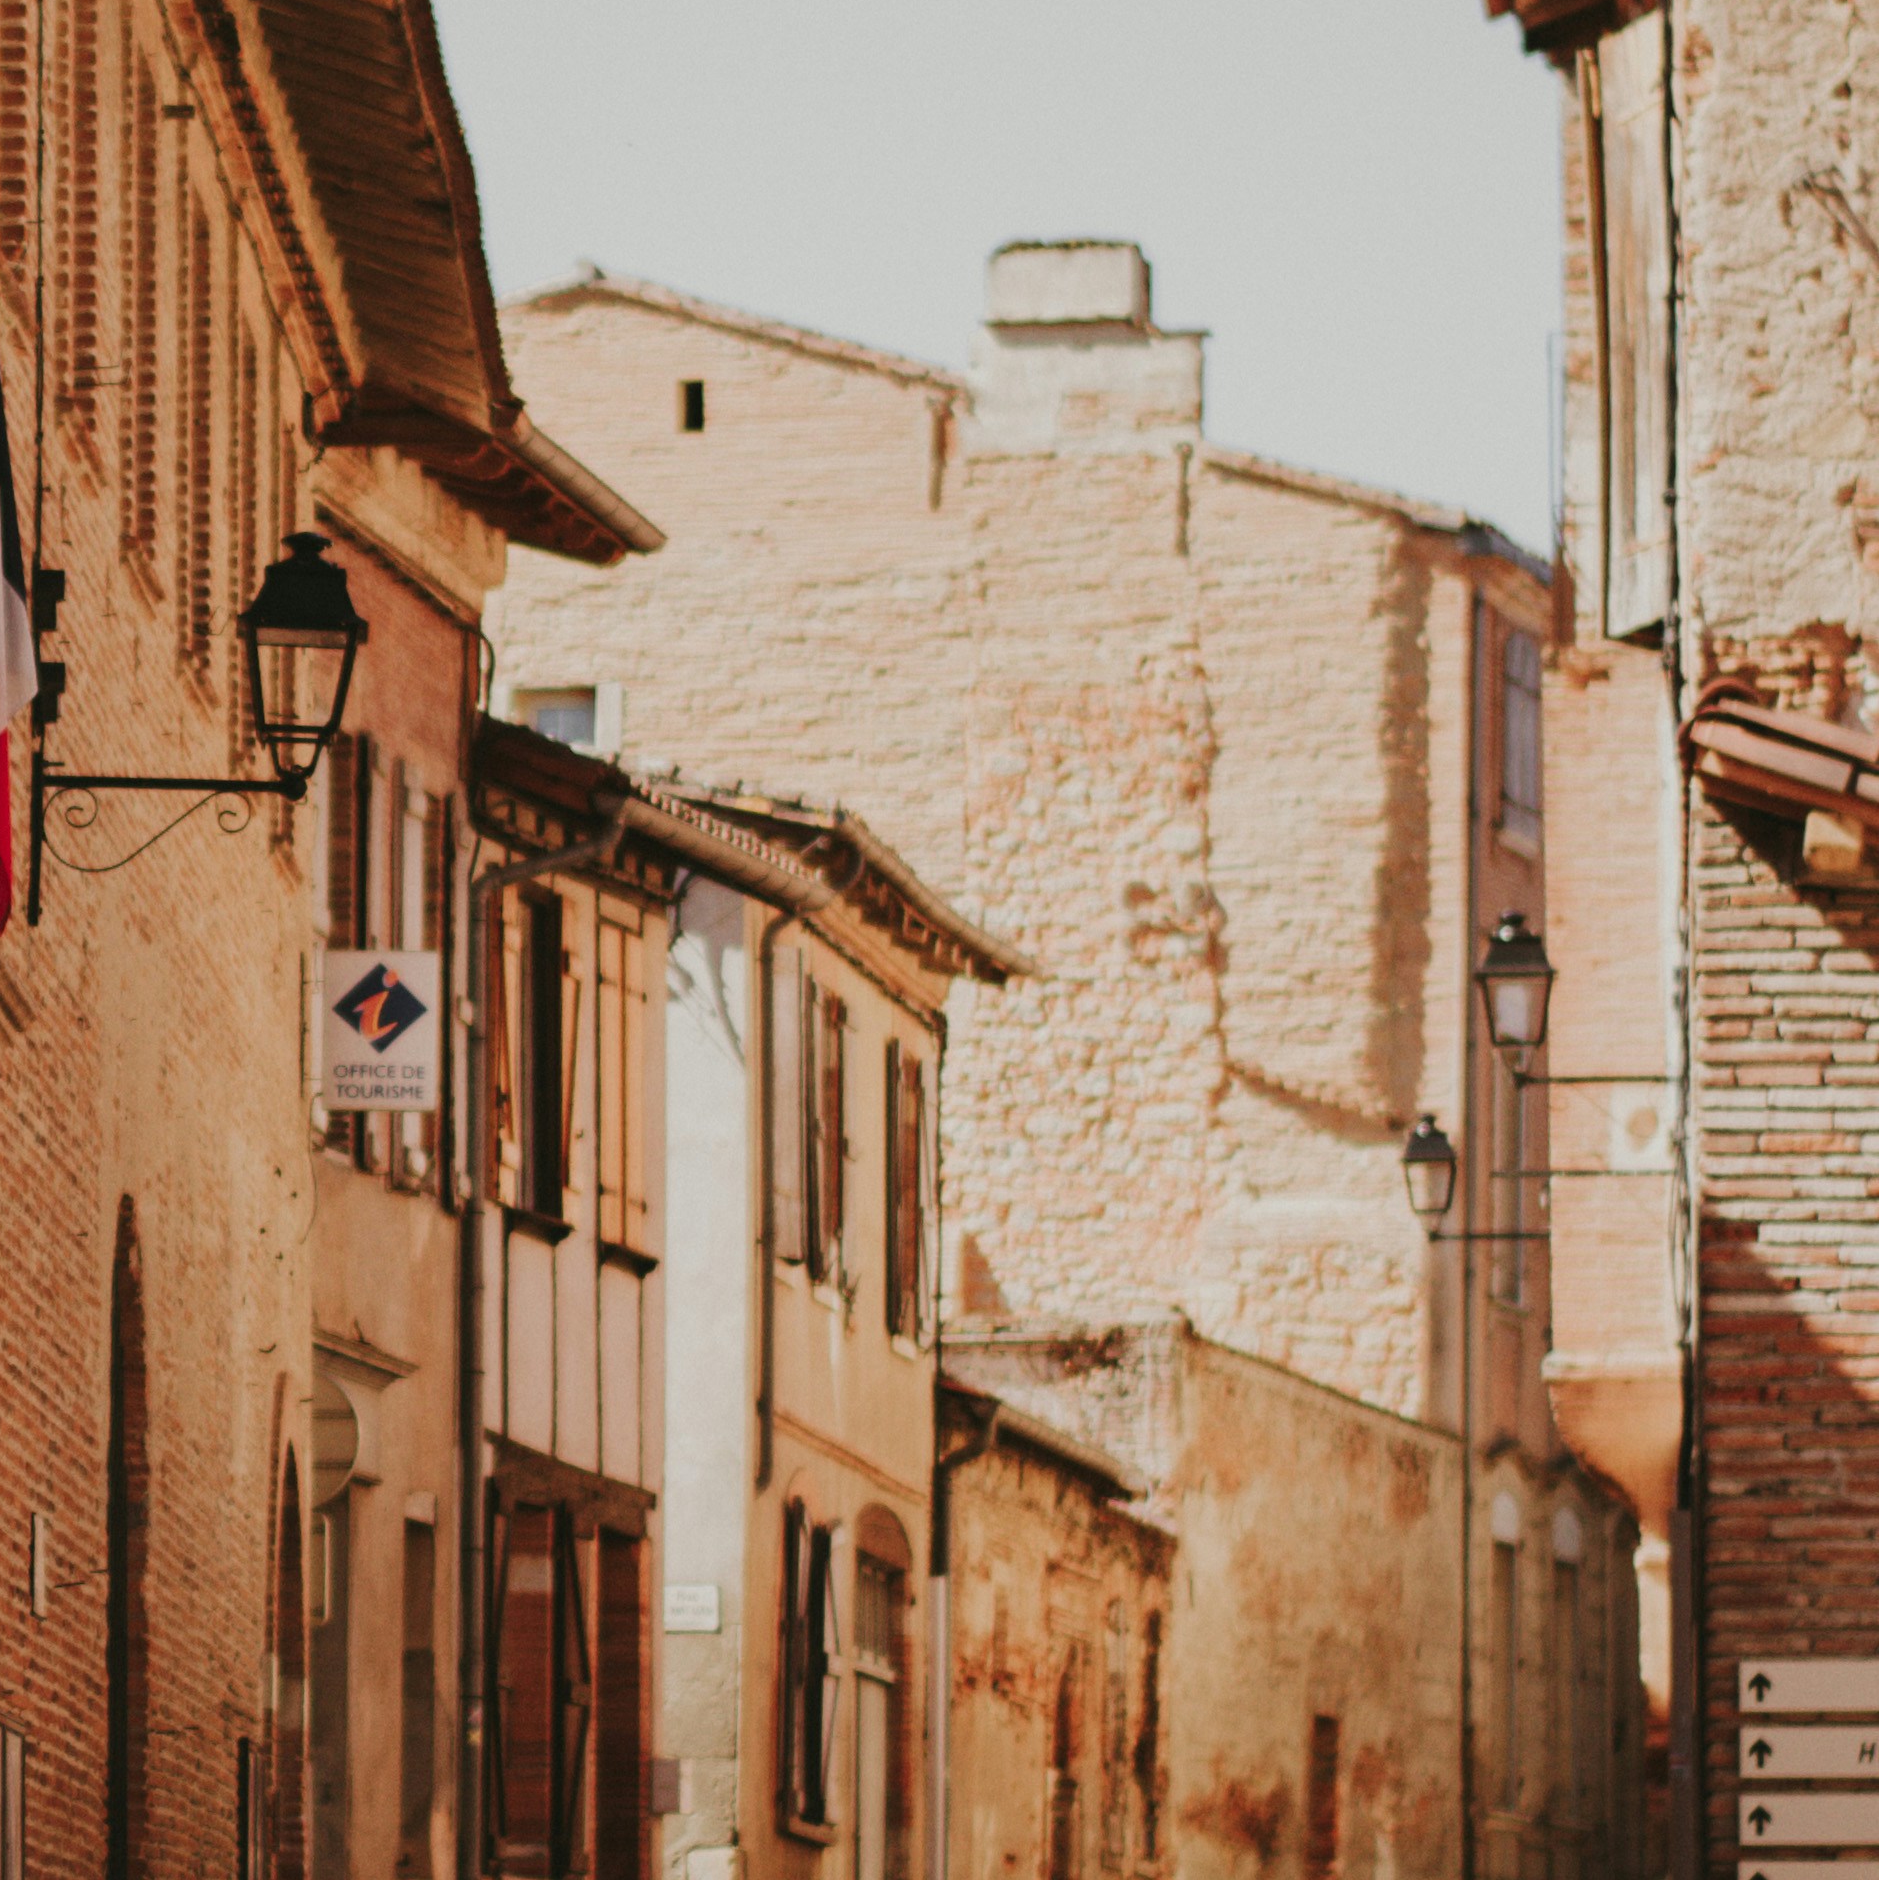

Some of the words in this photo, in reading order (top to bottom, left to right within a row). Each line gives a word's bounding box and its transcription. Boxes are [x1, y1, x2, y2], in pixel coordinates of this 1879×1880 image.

[333, 1064, 396, 1078] OFFICE
[402, 1065, 425, 1079] DE
[336, 1083, 424, 1099] TOURISME
